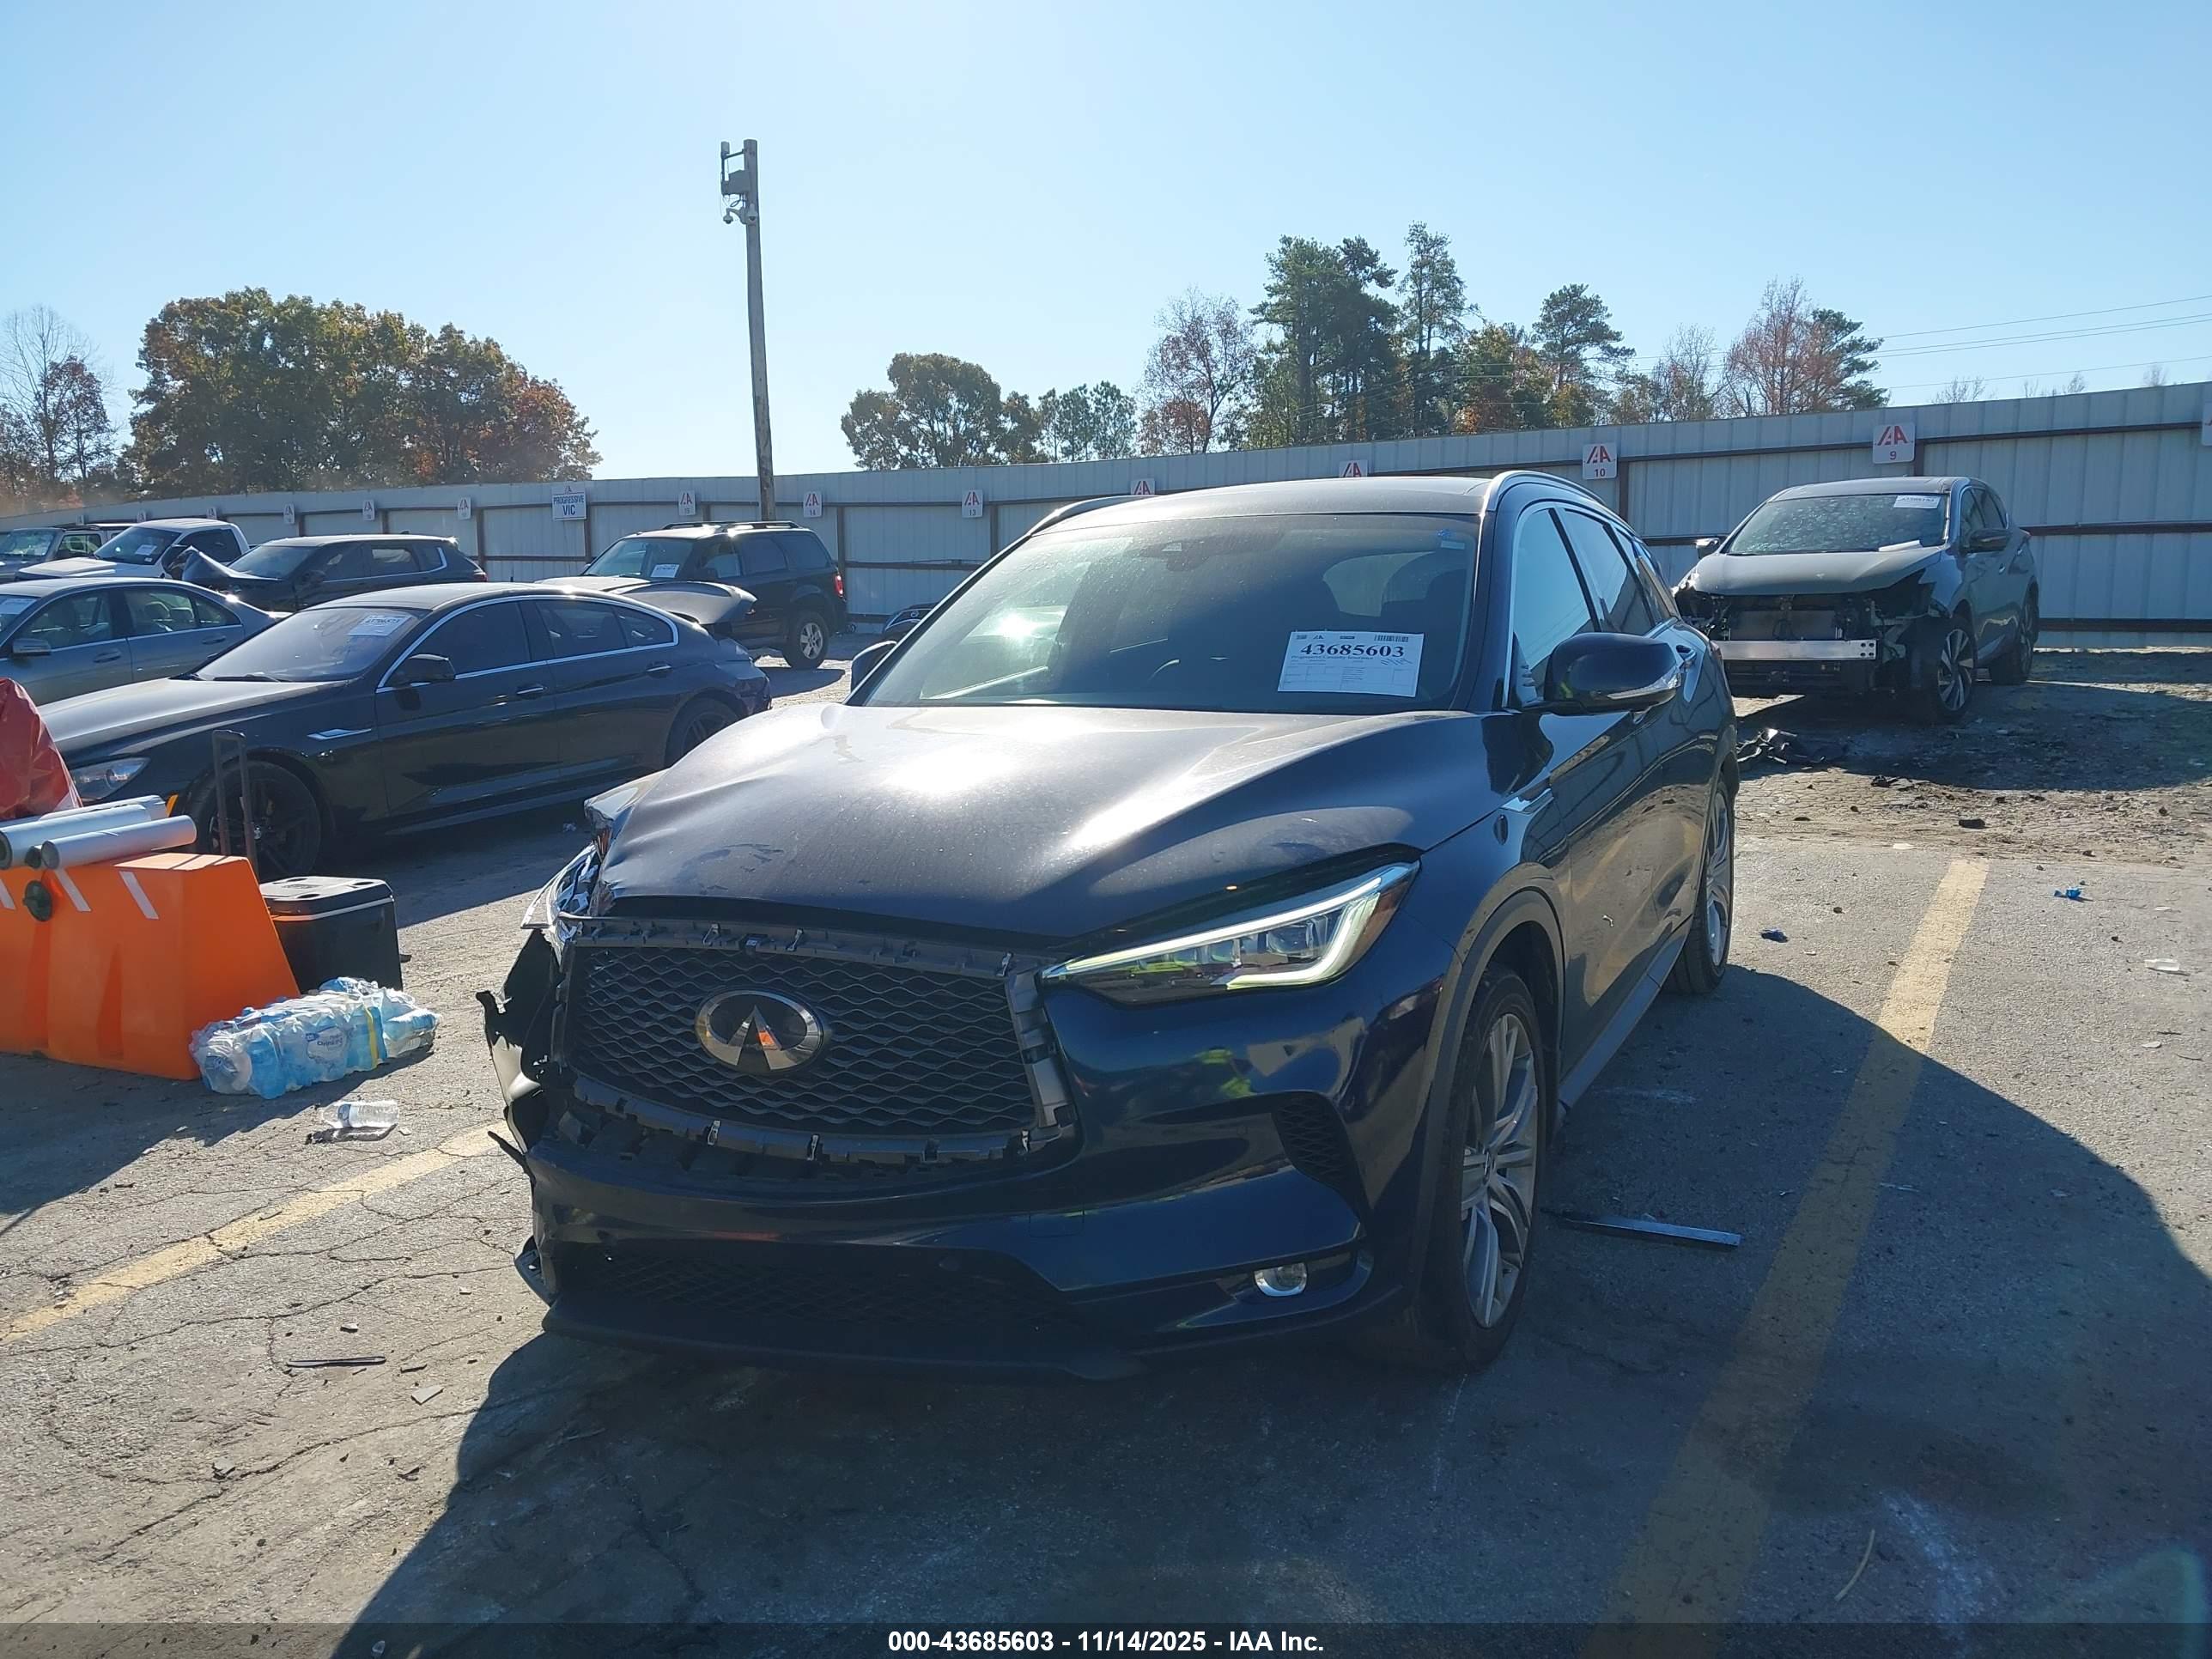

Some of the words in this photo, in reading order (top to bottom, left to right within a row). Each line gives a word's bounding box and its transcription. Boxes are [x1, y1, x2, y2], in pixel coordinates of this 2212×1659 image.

[1889, 450, 1897, 460] 9
[1594, 468, 1607, 478] 10
[553, 495, 585, 504] PROGRESSIVE
[562, 504, 576, 516] VIC
[1301, 644, 1404, 658] 43685603
